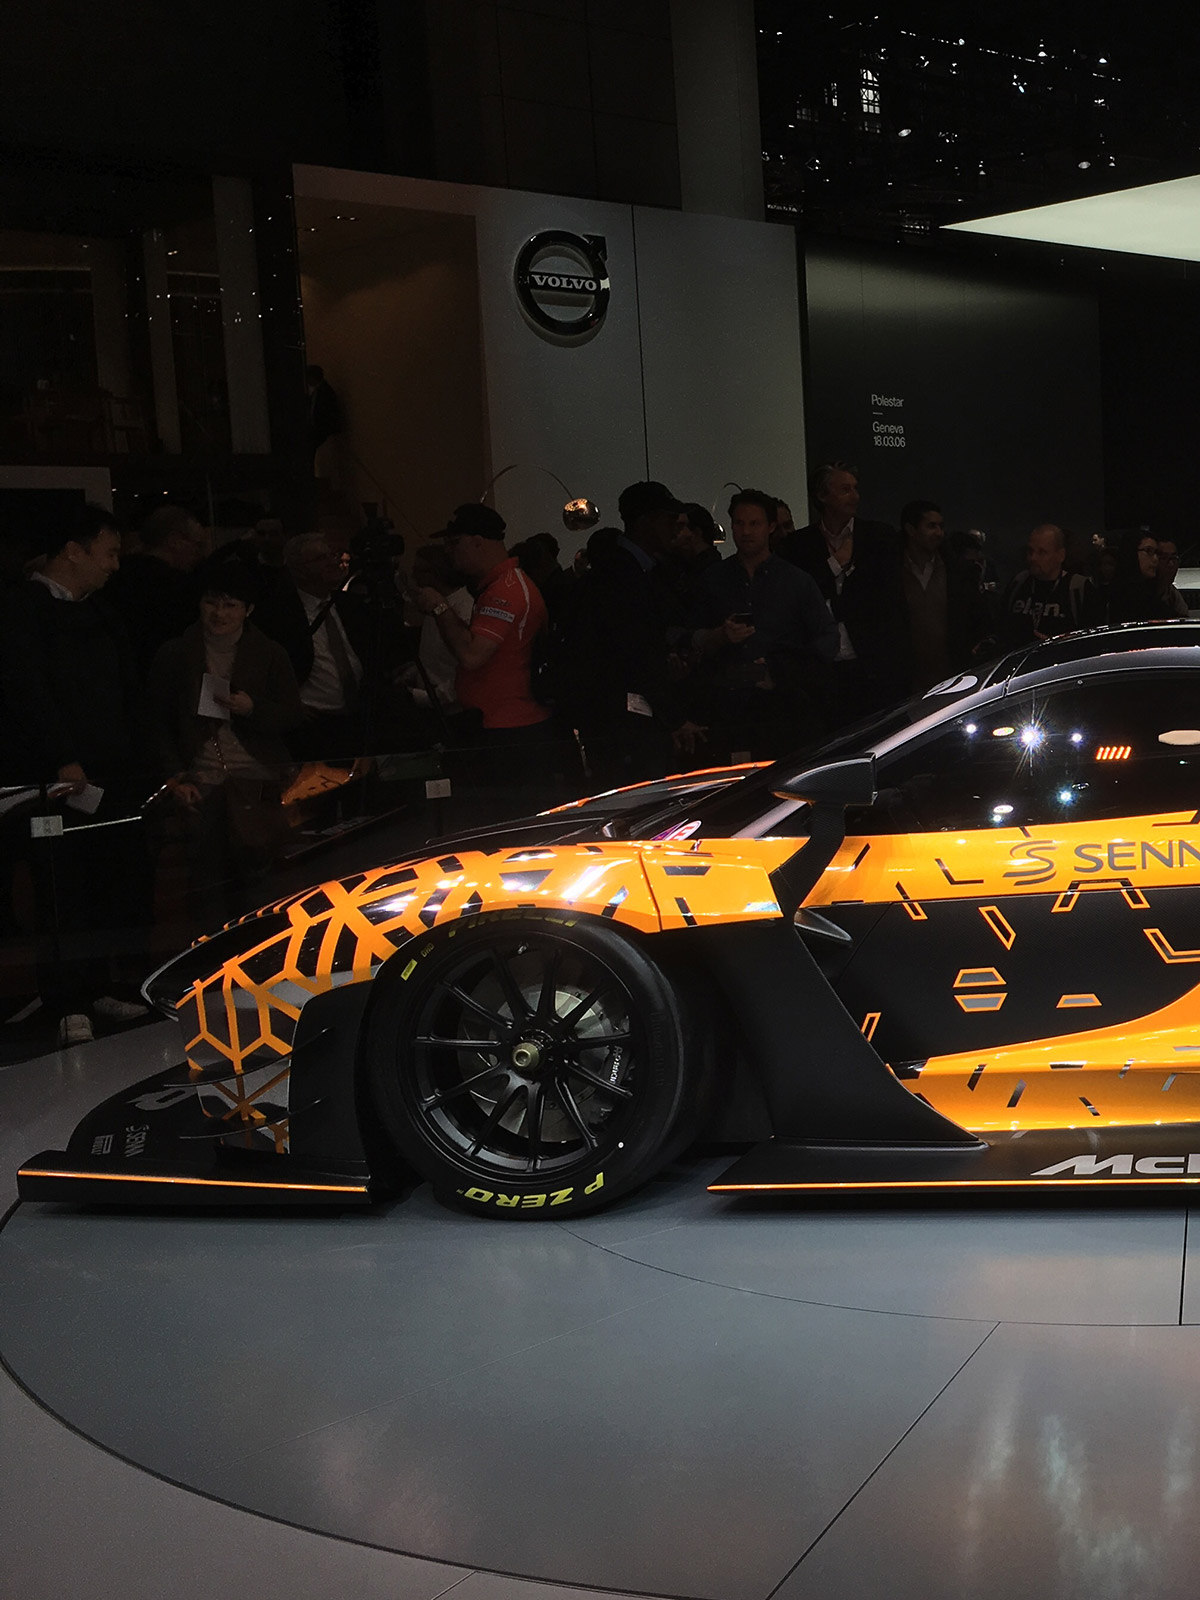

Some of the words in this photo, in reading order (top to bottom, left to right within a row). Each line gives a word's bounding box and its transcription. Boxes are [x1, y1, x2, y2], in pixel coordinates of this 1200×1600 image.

[531, 274, 597, 291] VOLVO
[871, 394, 904, 407] Polestar
[872, 421, 904, 434] Geneva
[873, 435, 906, 448] 18.03.06
[583, 1171, 606, 1195] P
[463, 1185, 575, 1209] ZERO
